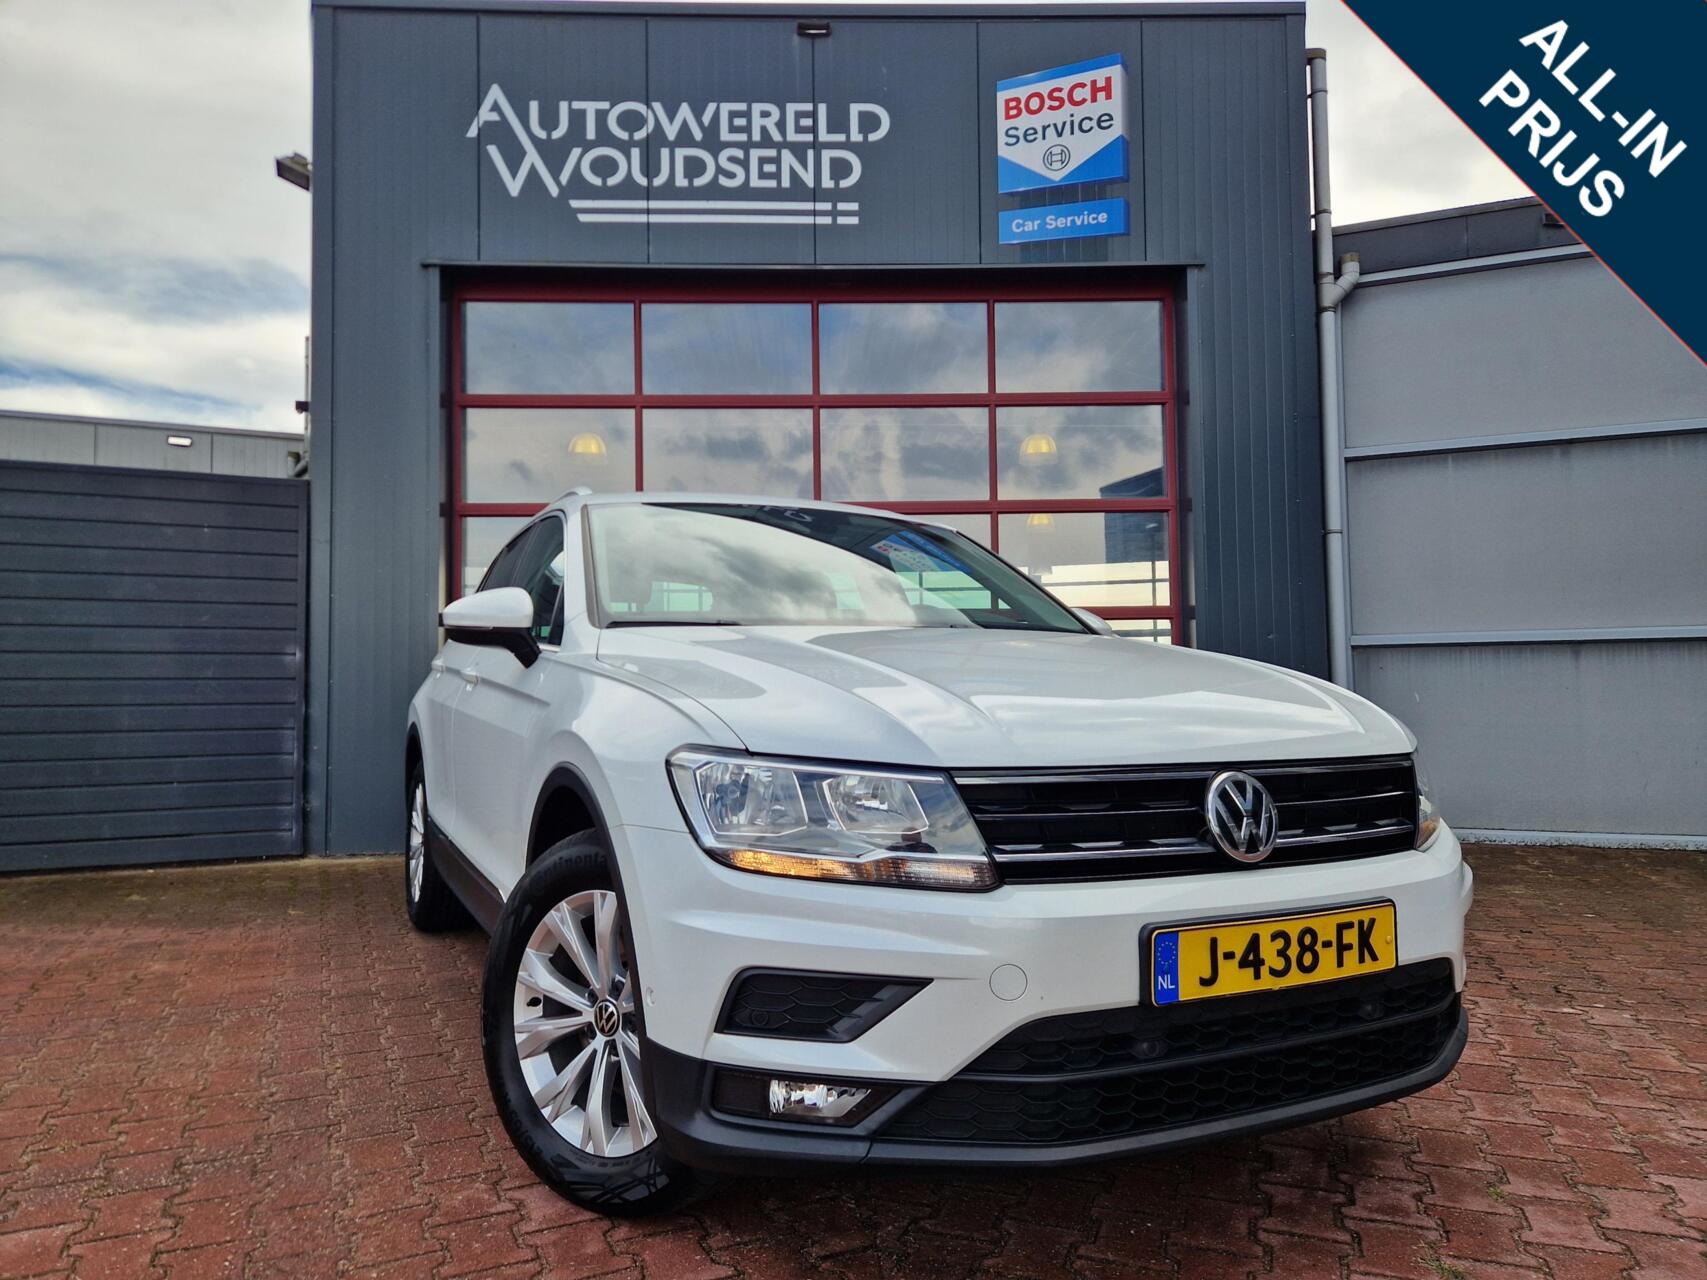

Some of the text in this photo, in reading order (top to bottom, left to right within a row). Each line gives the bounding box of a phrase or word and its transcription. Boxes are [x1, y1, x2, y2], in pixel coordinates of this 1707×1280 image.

[466, 83, 890, 142] AUTOWERELD
[1004, 76, 1112, 120] BOSCH
[1004, 112, 1113, 146] Service
[486, 145, 862, 197] WOUDSEND
[1012, 211, 1108, 232] Car Service
[1158, 917, 1379, 990] NL J-438-FK
